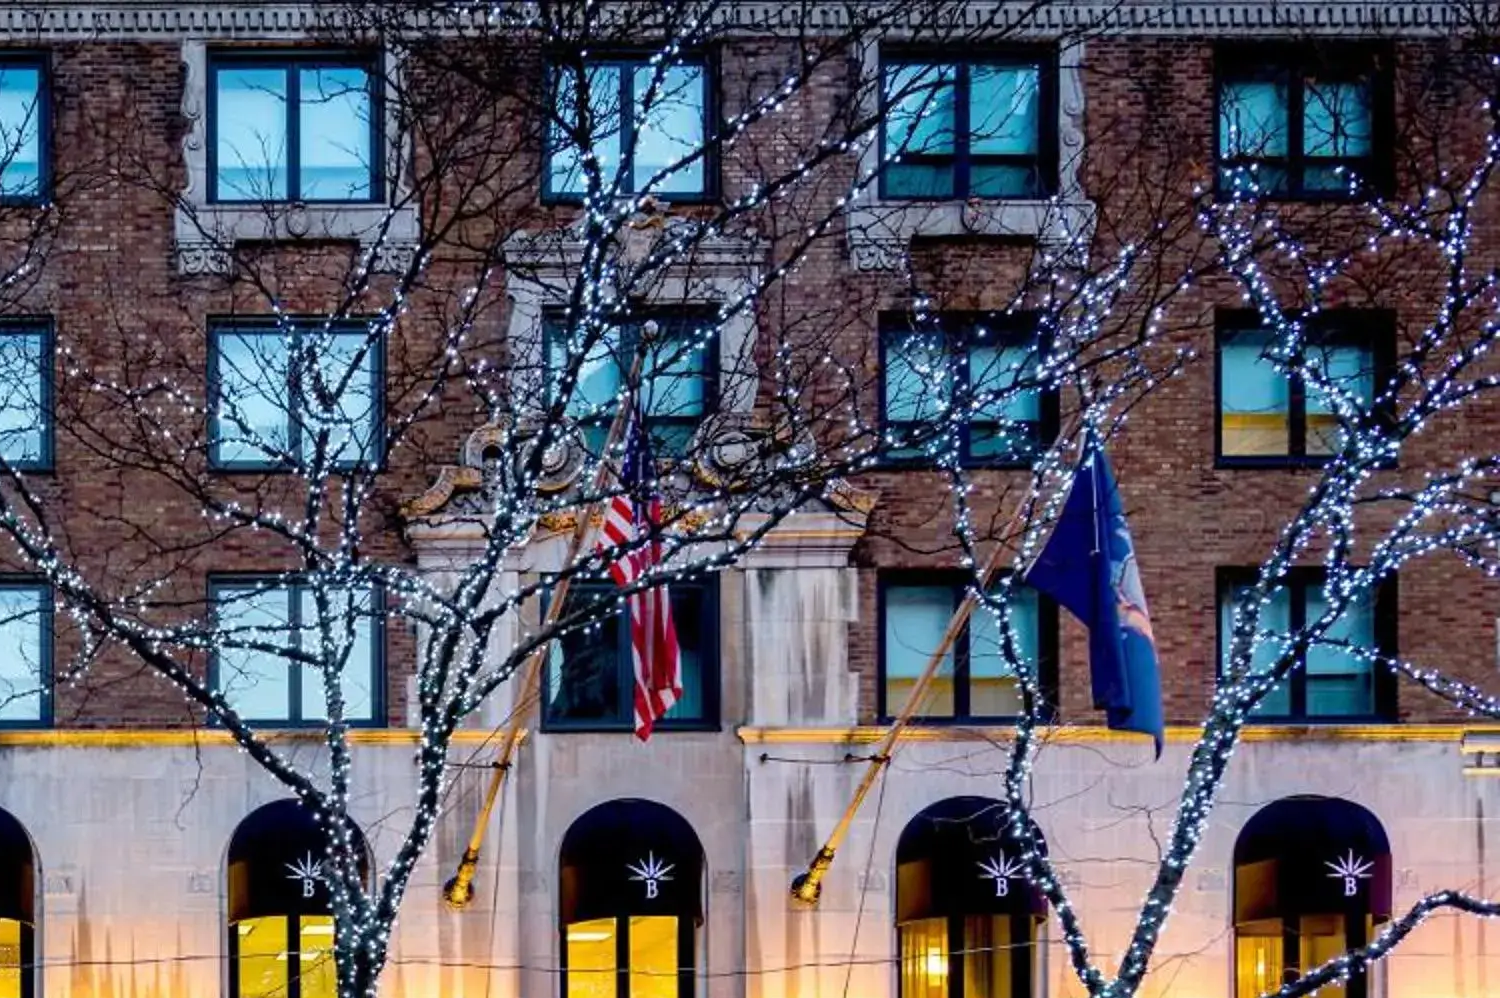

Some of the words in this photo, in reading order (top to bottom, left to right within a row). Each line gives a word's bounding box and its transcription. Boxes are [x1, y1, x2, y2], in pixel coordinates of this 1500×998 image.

[303, 879, 315, 898] B
[646, 880, 659, 898] B
[996, 877, 1008, 896] B
[1344, 877, 1357, 896] B
